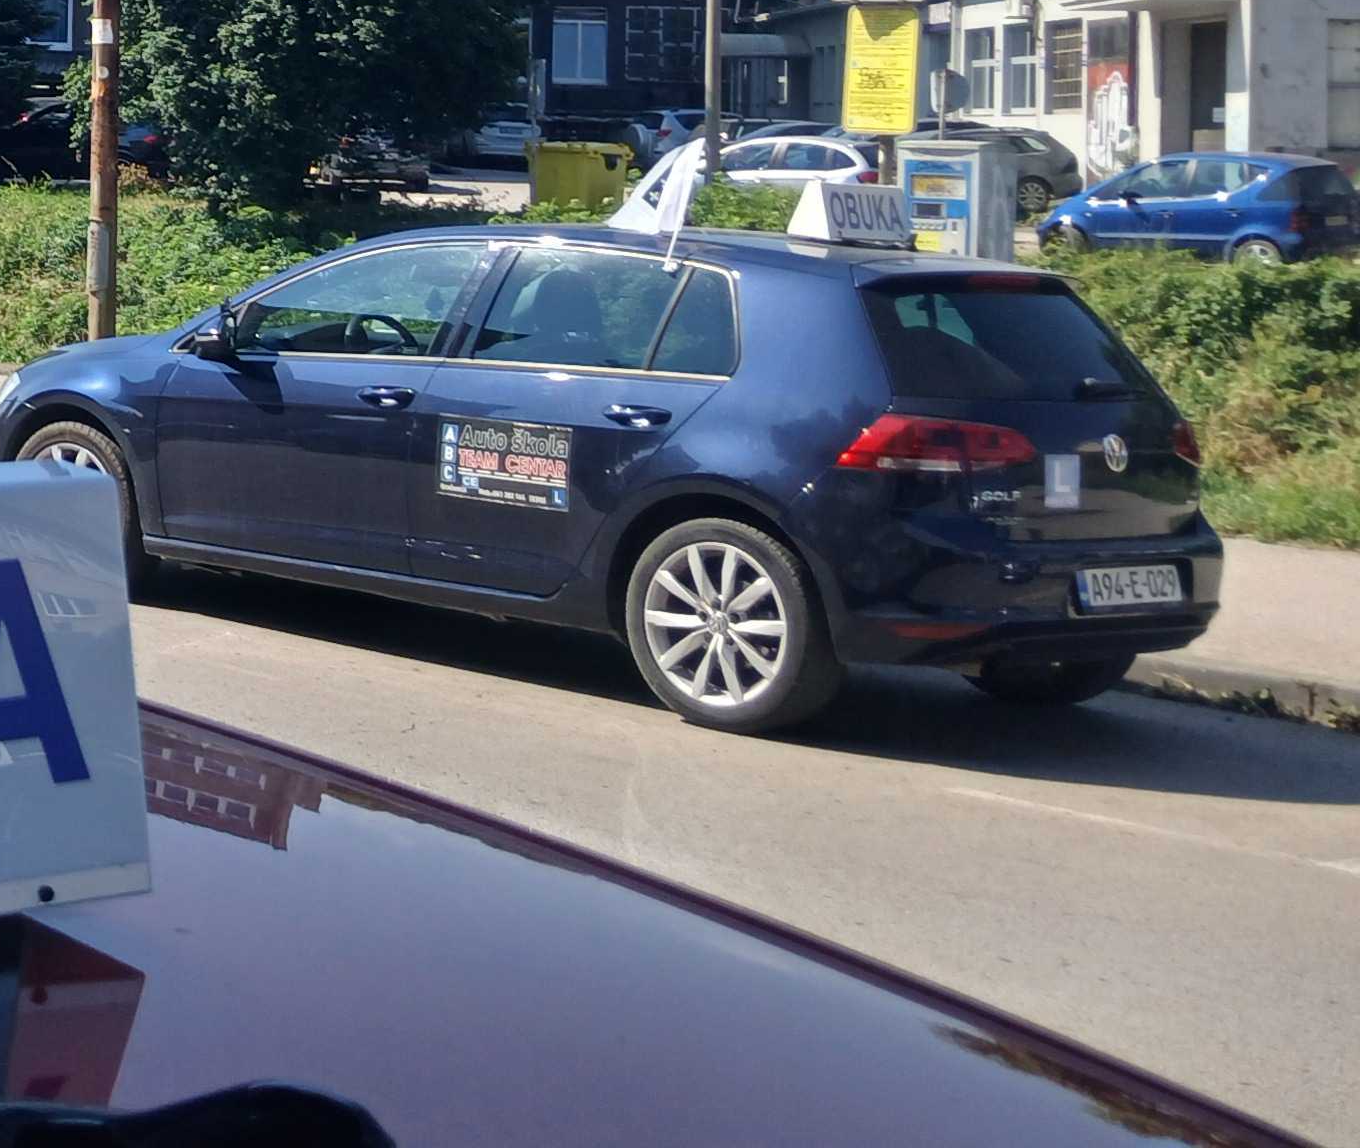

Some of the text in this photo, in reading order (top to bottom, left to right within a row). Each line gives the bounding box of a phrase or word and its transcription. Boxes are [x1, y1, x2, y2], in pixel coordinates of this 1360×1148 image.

[830, 192, 904, 231] OBUKA
[443, 426, 454, 442] A
[459, 425, 569, 458] Auto škola
[444, 446, 453, 460] B
[458, 448, 567, 478] TEAM CENTAR
[443, 465, 453, 480] C
[981, 491, 1021, 501] GOLF
[1090, 569, 1176, 602] A94-E-029
